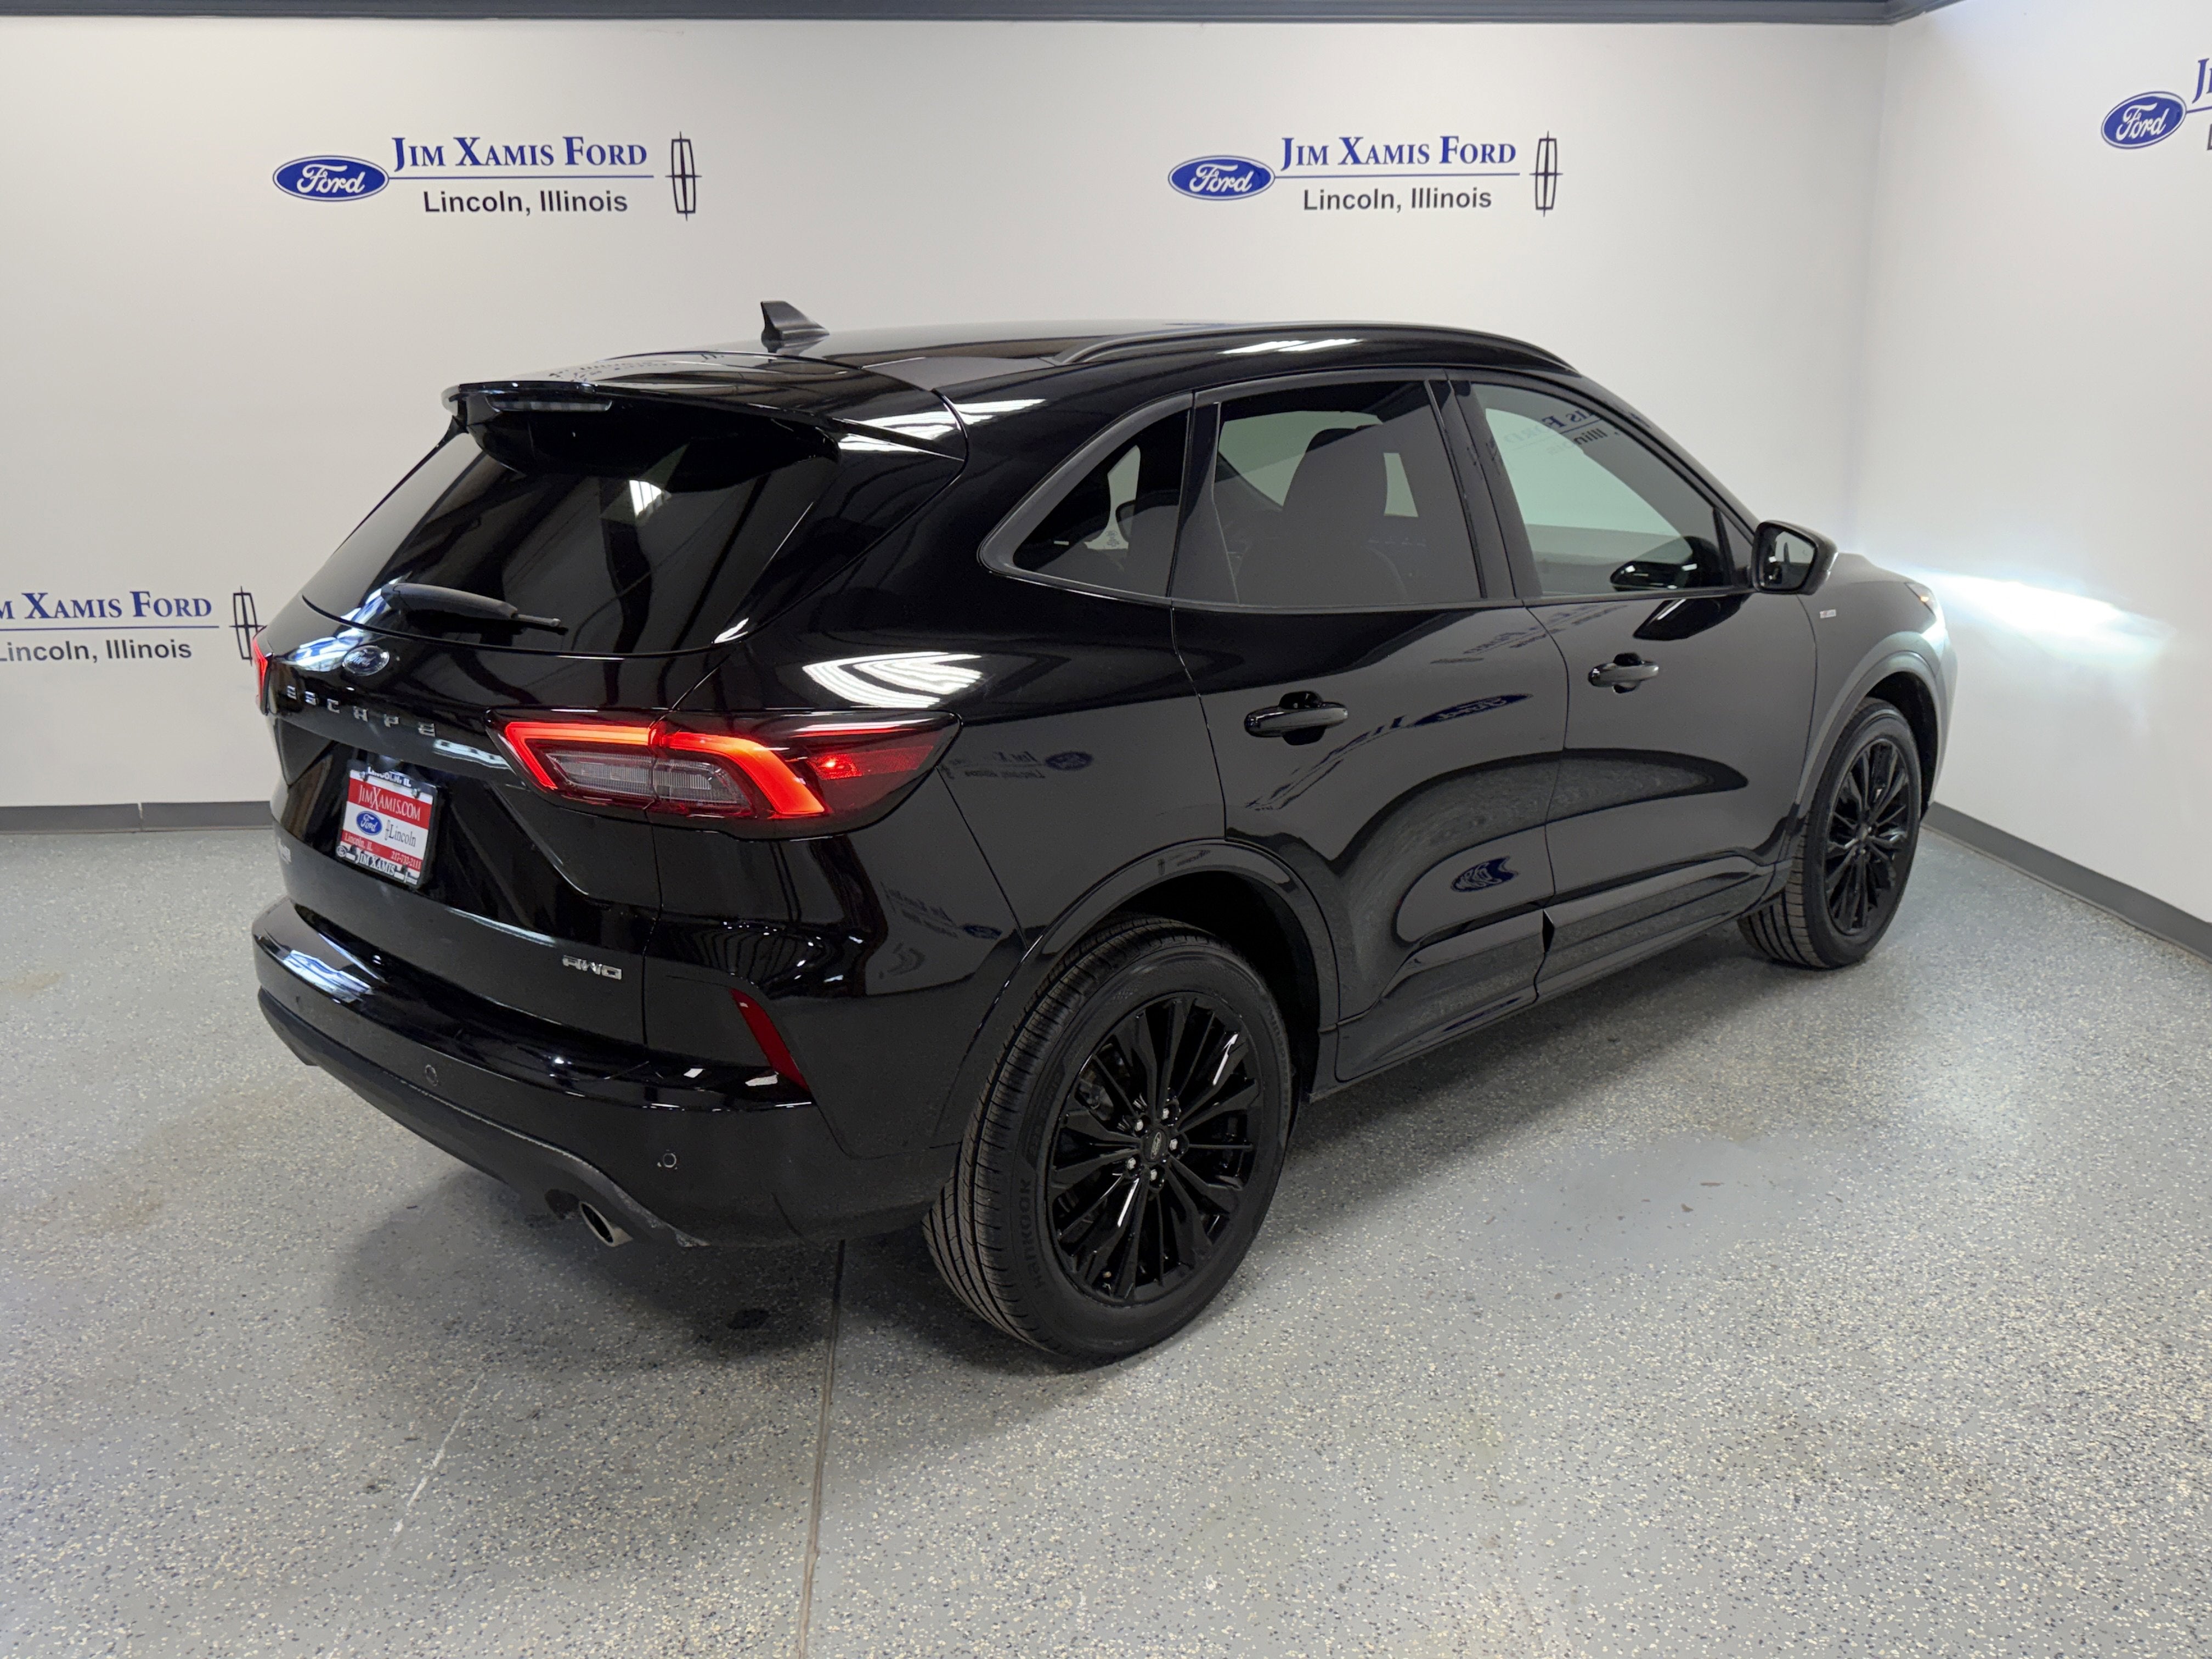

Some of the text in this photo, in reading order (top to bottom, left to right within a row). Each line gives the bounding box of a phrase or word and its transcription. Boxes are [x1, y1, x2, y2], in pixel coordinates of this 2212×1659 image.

[2116, 103, 2170, 141] Ford
[392, 137, 647, 172] JIM XAMIS FORD
[1281, 136, 1516, 171] JIM XAMIS FORD
[297, 164, 365, 194] Ford
[1189, 163, 1252, 194] Ford
[424, 190, 628, 216] Lincoln, Illinois
[1304, 187, 1492, 213] Lincoln, Illinois
[21, 592, 122, 619] XAMIS
[129, 591, 212, 617] FORD
[0, 639, 192, 663] incoln, Illinois
[360, 814, 378, 832] Ford
[388, 824, 416, 847] Lincoln
[562, 955, 622, 980] AWD
